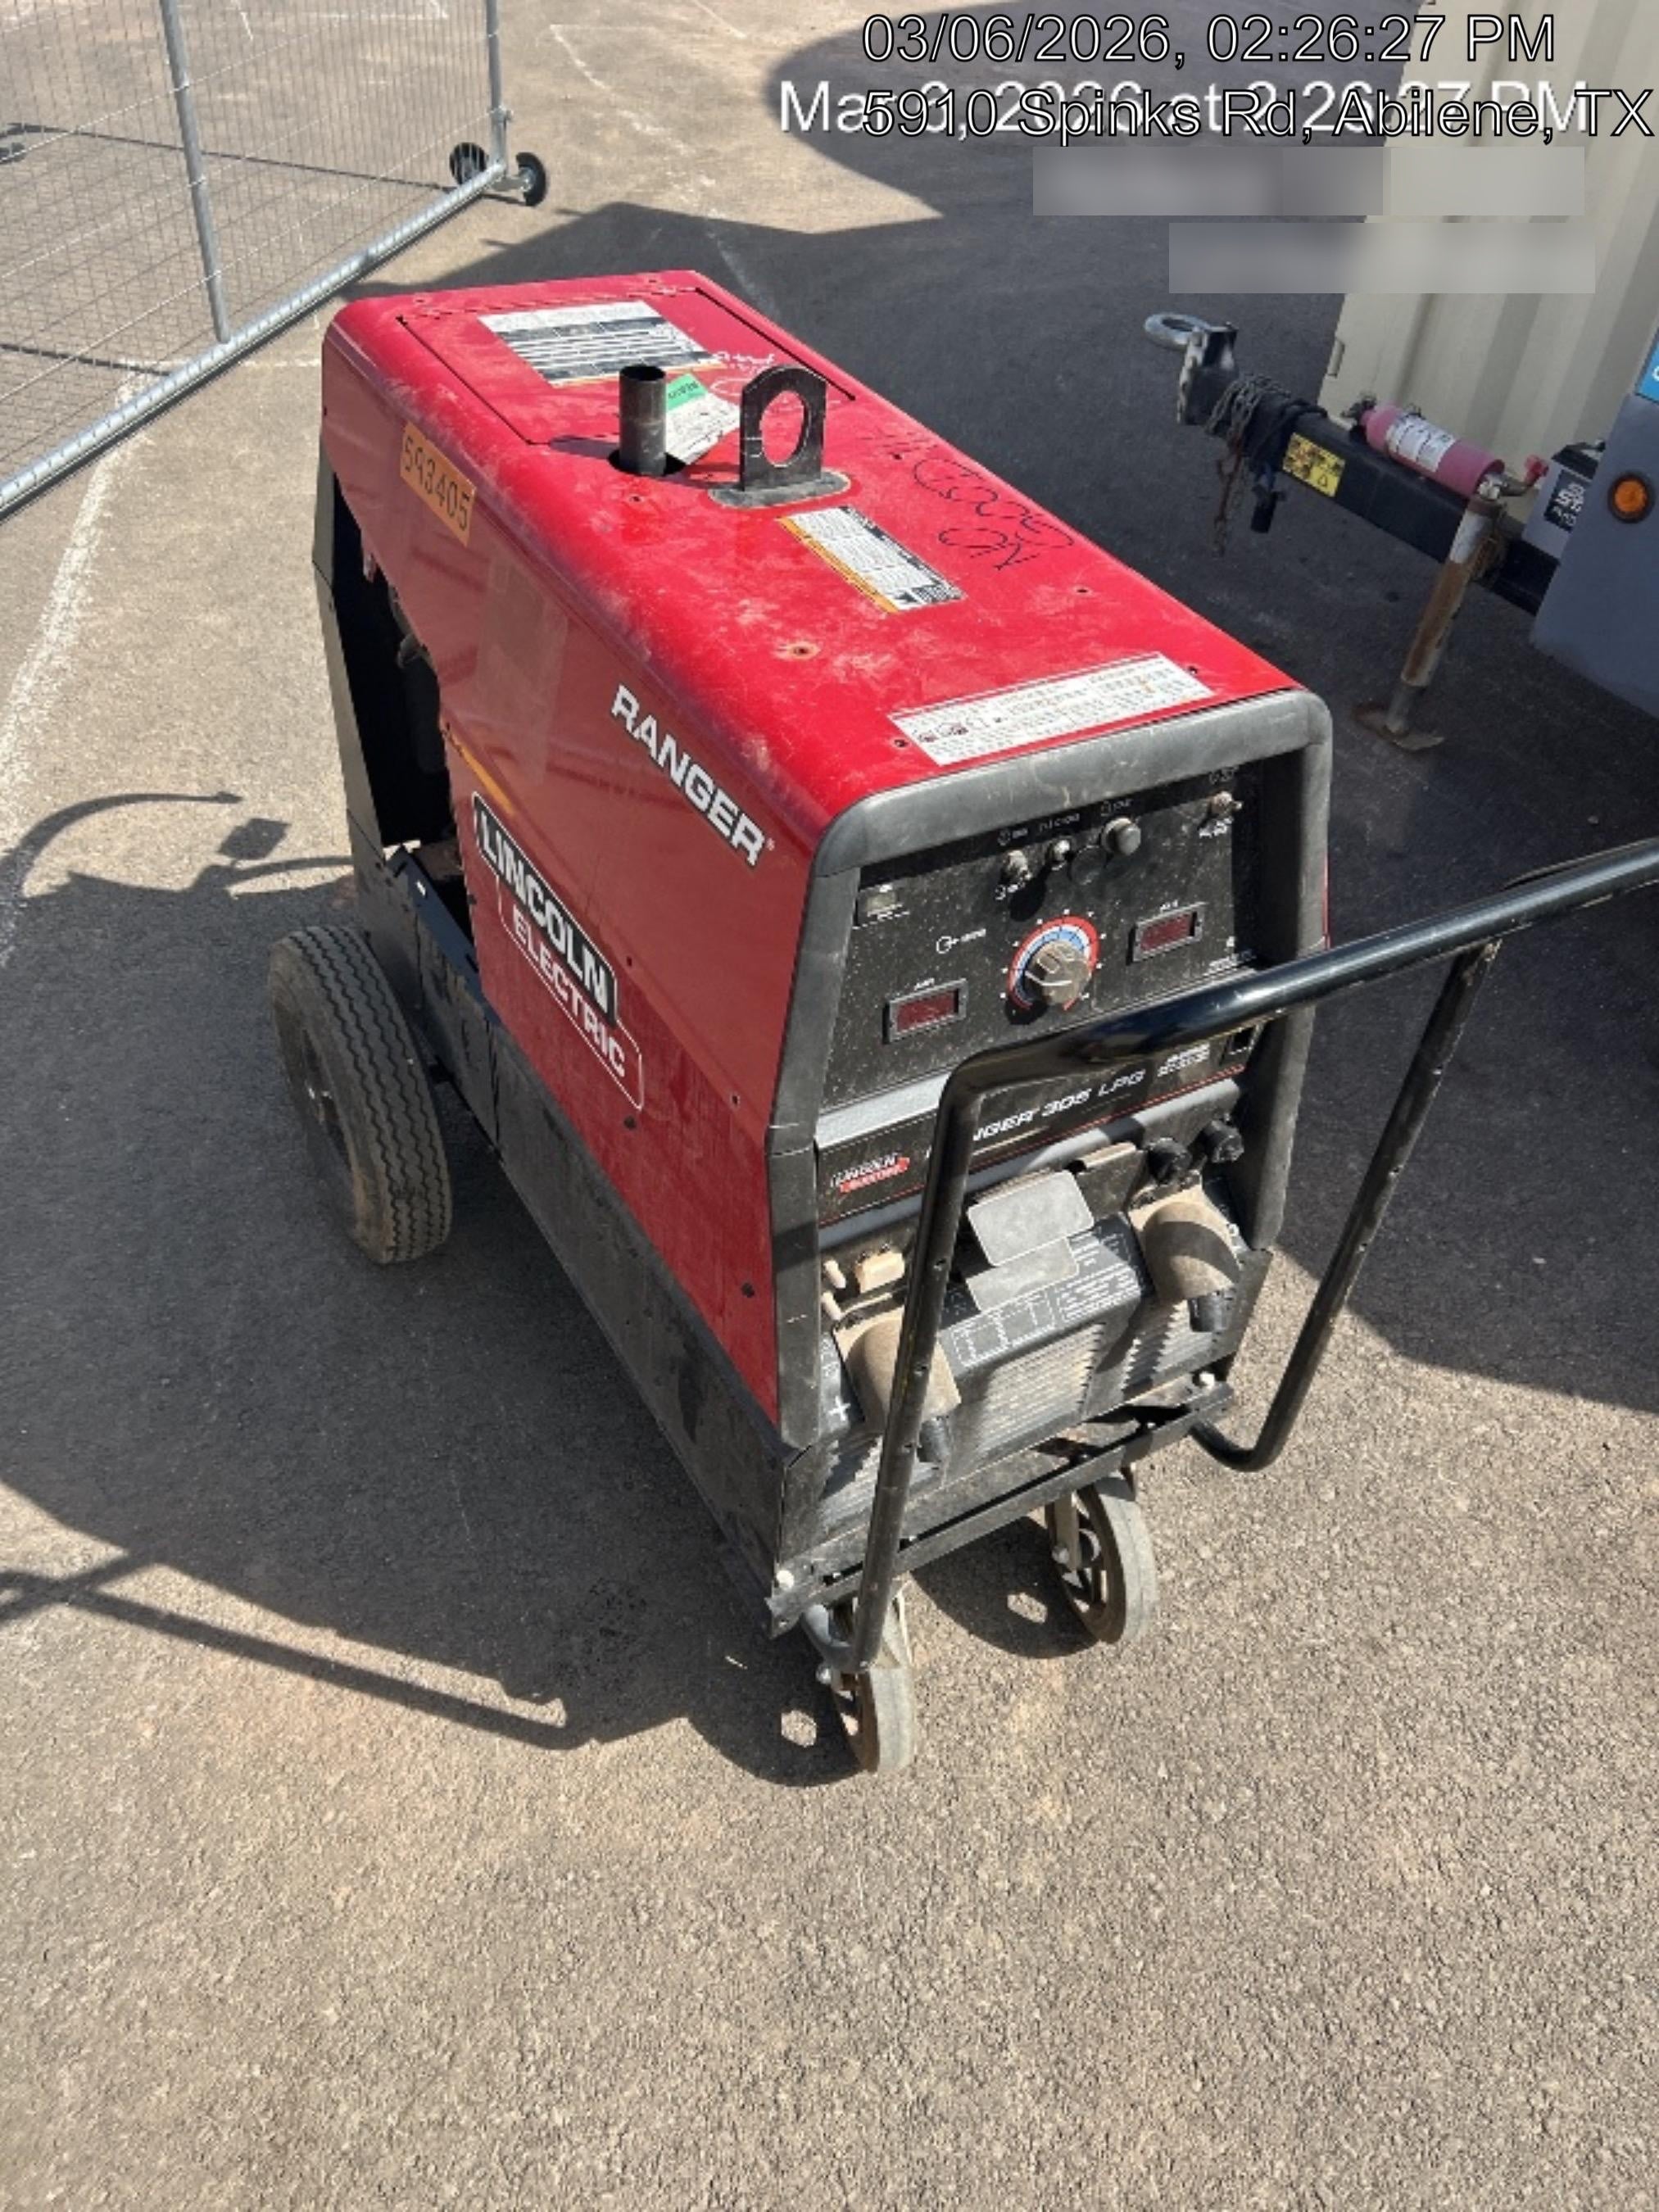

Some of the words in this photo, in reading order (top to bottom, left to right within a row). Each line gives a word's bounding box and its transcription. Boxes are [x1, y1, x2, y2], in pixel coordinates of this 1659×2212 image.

[403, 436, 471, 533] 593405
[611, 683, 765, 868] RANGER
[478, 809, 609, 1014] LINCOLN
[512, 903, 627, 1079] ELECTRIC
